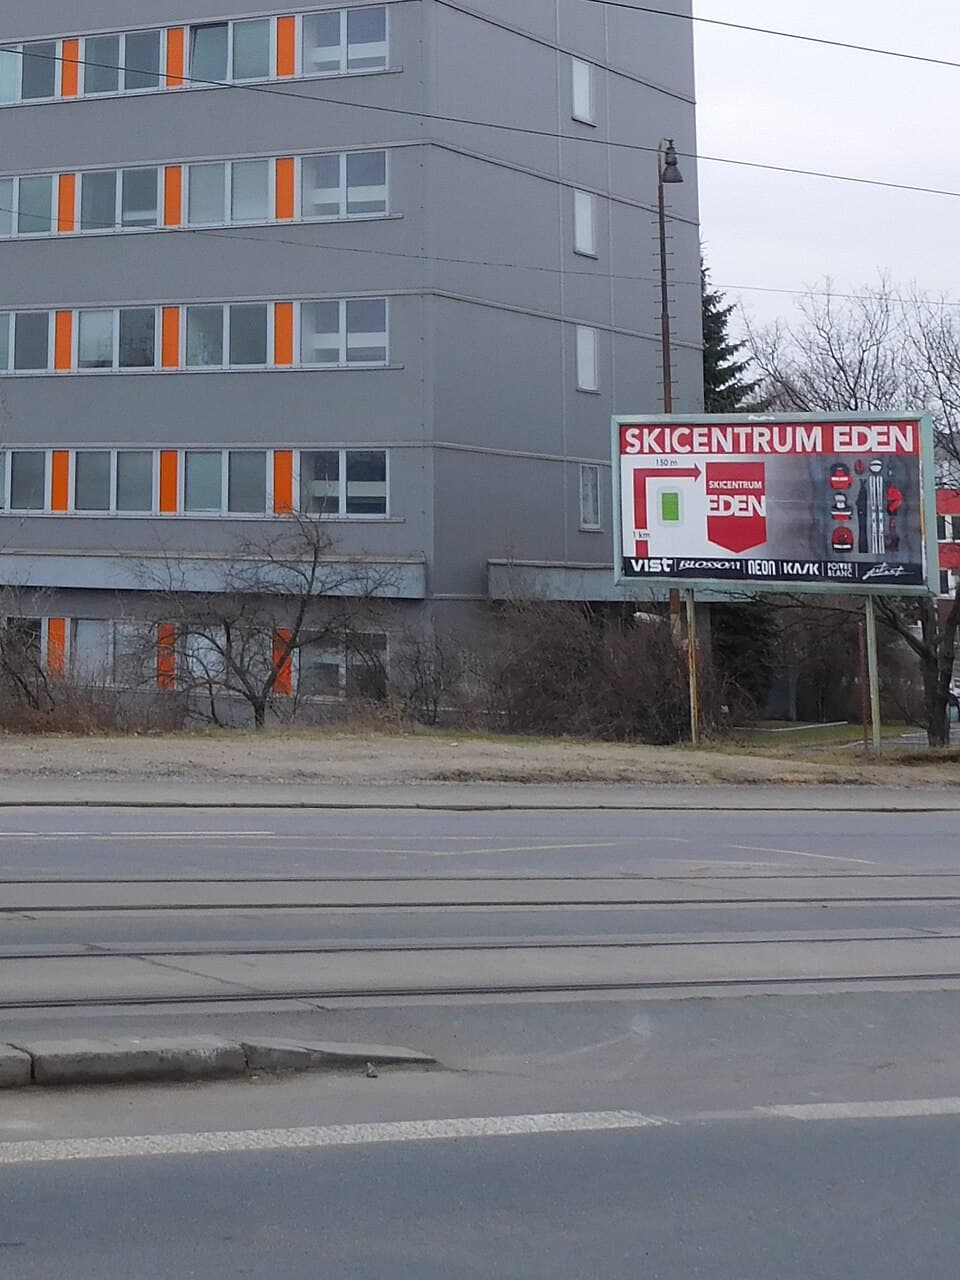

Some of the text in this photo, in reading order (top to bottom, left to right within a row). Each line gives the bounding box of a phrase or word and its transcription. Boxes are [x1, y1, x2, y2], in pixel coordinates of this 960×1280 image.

[625, 426, 913, 453] SKICENTRUM EDEN
[708, 480, 762, 489] SKICENTRUM
[706, 494, 767, 517] EDEN
[679, 560, 741, 570] BLOSSOM
[827, 569, 853, 577] BLANC
